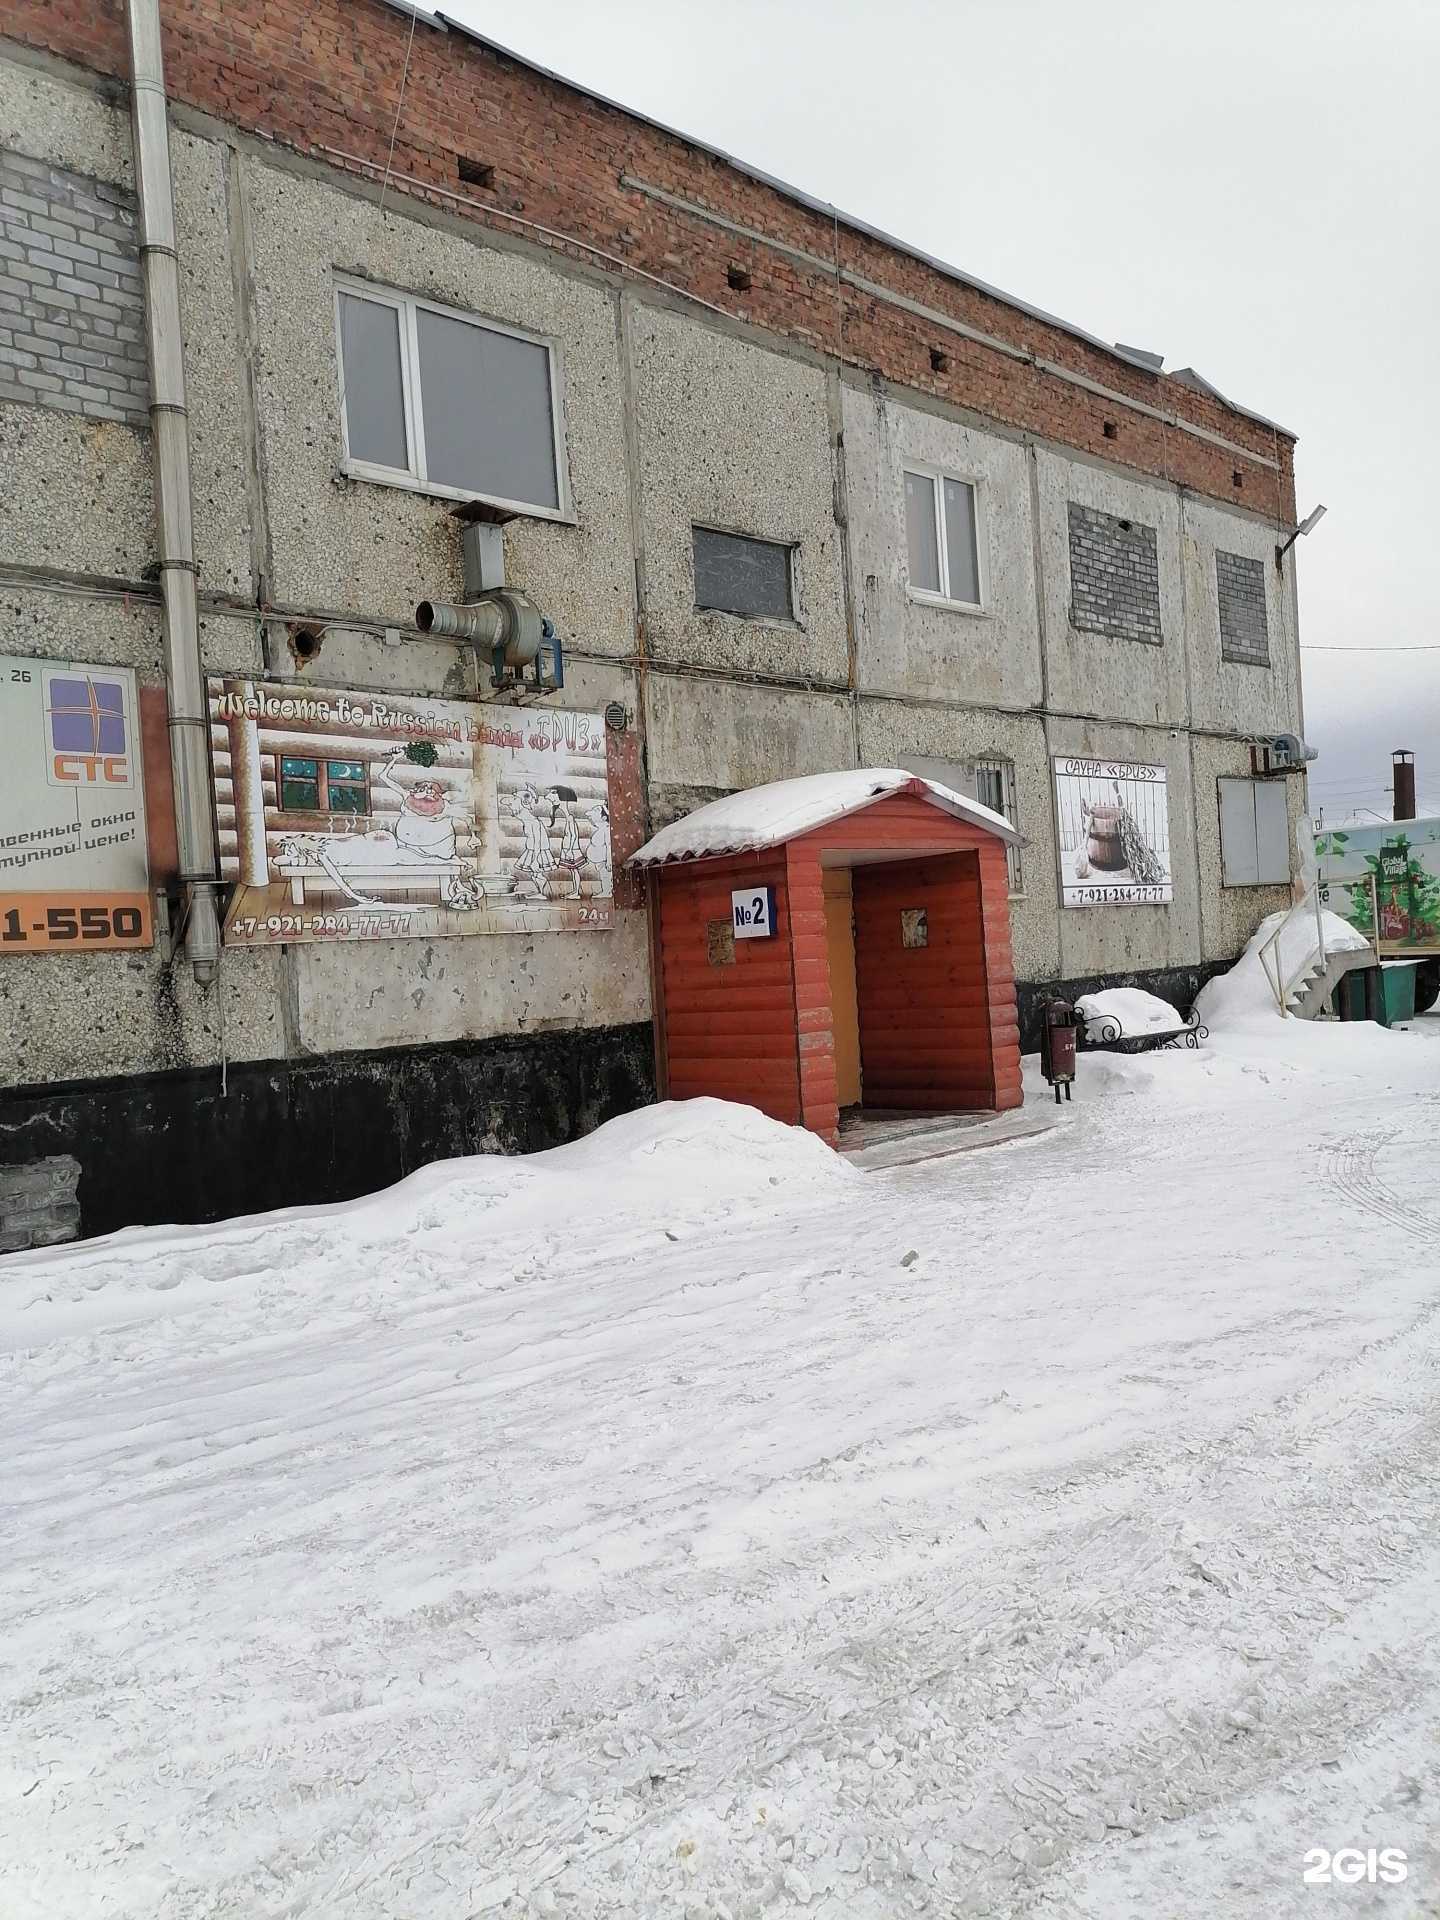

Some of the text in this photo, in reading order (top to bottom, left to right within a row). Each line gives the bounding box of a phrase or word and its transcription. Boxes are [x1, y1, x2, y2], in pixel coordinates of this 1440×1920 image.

[11, 669, 32, 683] 26
[218, 690, 331, 725] Welcome
[336, 697, 364, 727] to
[370, 701, 462, 743] Russian
[54, 754, 128, 783] СТС
[1065, 759, 1102, 776] САУНА
[91, 811, 136, 829] окна
[84, 828, 136, 850] цене!
[2, 907, 143, 942] 1-550
[231, 913, 412, 938] +7-921-284-77-77
